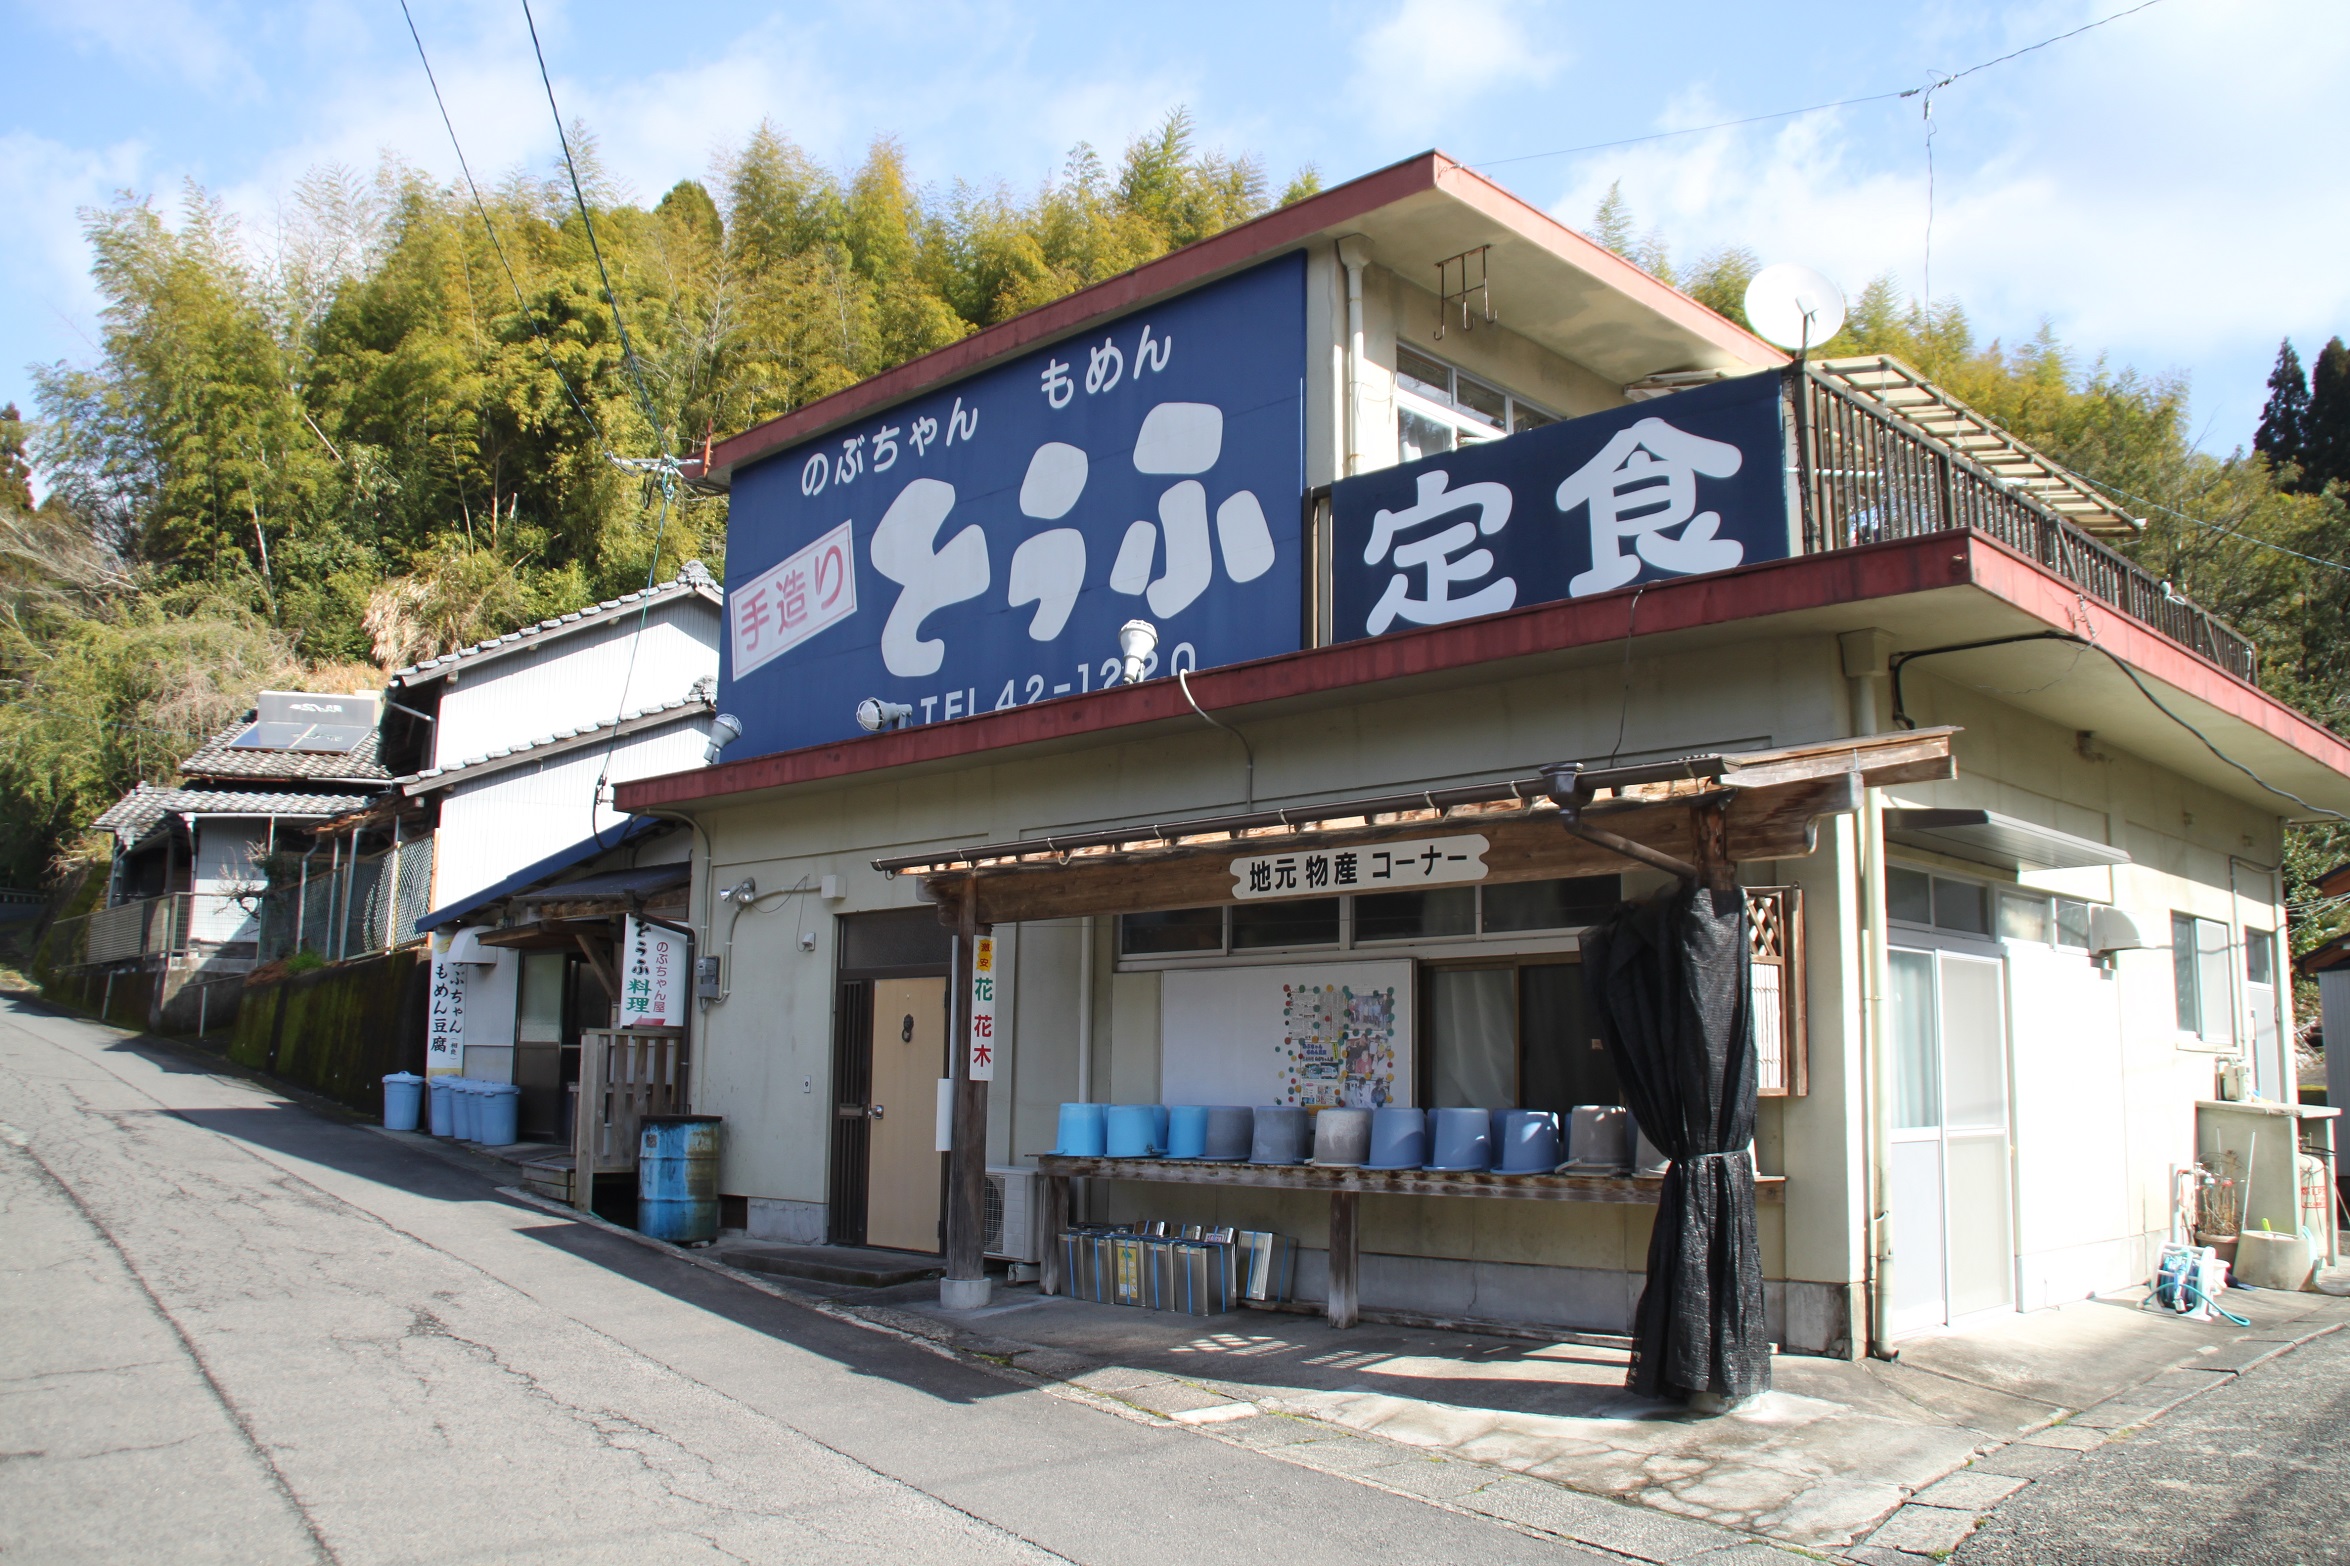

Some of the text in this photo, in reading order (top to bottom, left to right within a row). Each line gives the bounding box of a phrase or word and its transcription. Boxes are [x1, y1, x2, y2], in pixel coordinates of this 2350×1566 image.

[1041, 324, 1171, 408] もめん
[802, 397, 979, 496] のぶちゃん
[870, 402, 1275, 677] とうふ
[1363, 416, 1744, 636] 定食
[741, 545, 843, 651] 手造り
[431, 963, 449, 1053] もめん豆腐
[653, 941, 669, 1013] のぶちゃん屋
